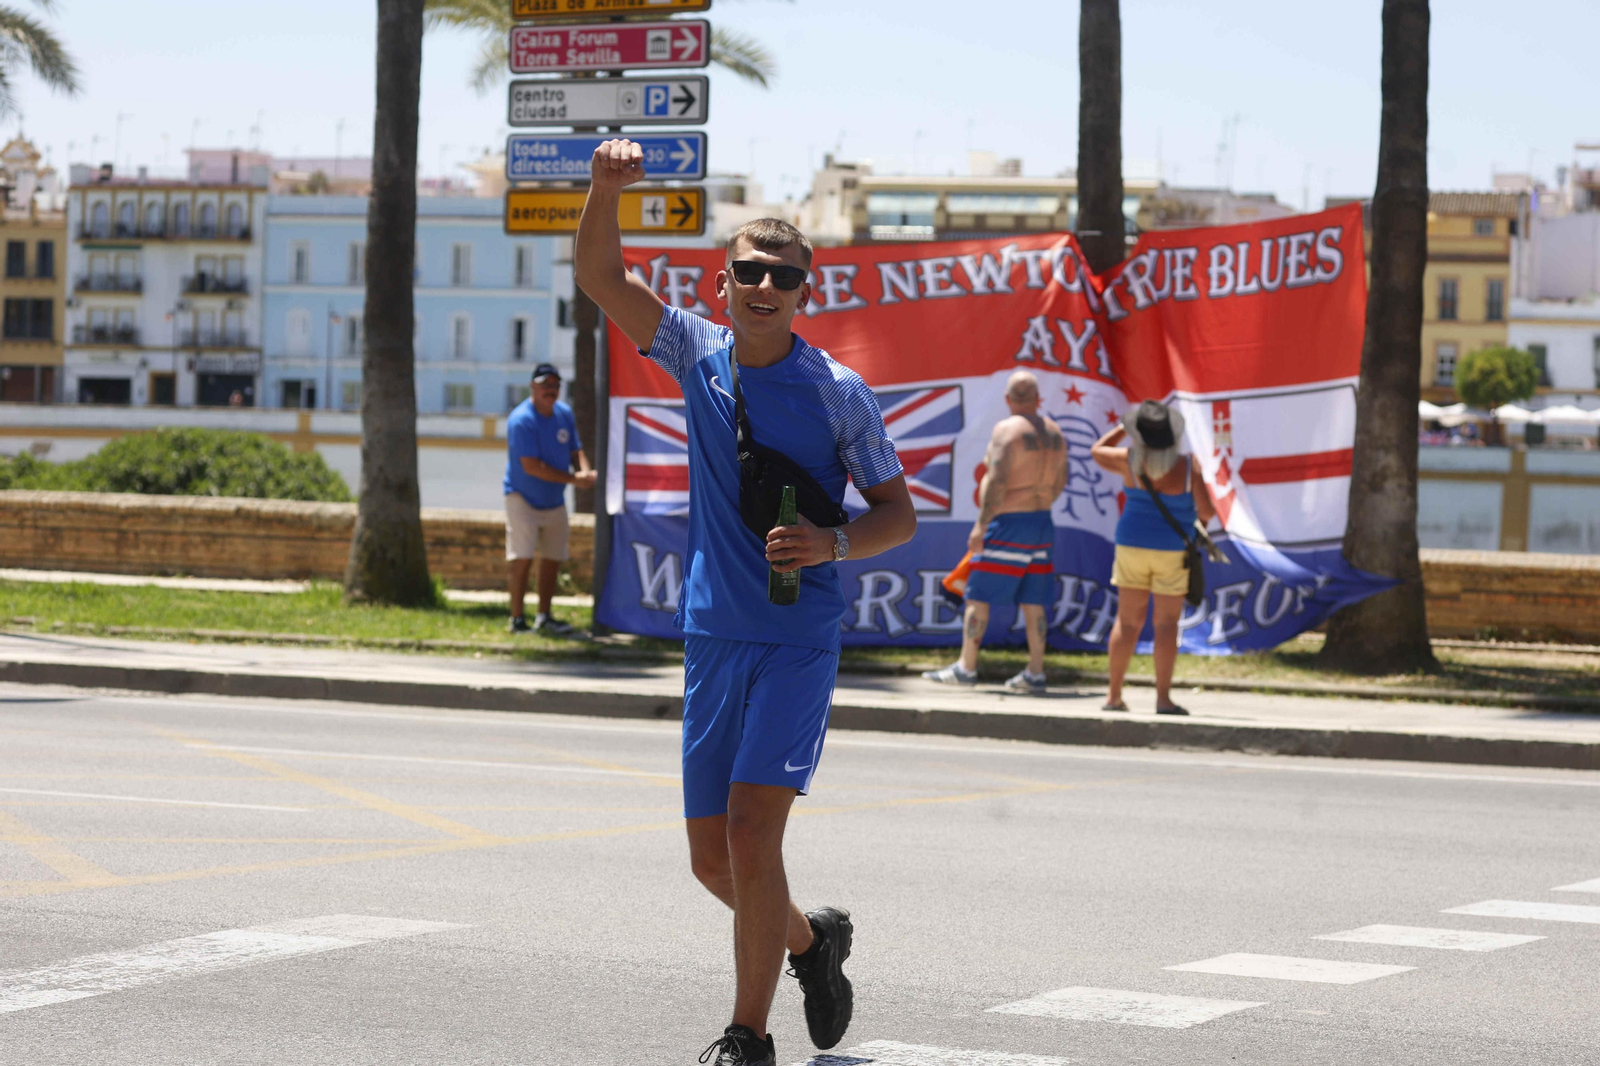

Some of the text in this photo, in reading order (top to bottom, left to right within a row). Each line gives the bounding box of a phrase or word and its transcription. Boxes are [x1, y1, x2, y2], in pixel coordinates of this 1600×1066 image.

[517, 30, 618, 48] Caixa Forum
[517, 48, 620, 66] Torre Sevilla
[514, 87, 565, 102] centro
[514, 103, 567, 118] ciudad
[514, 141, 558, 157] todas
[875, 243, 1099, 312] NEWTO
[1207, 225, 1344, 299] BLUES
